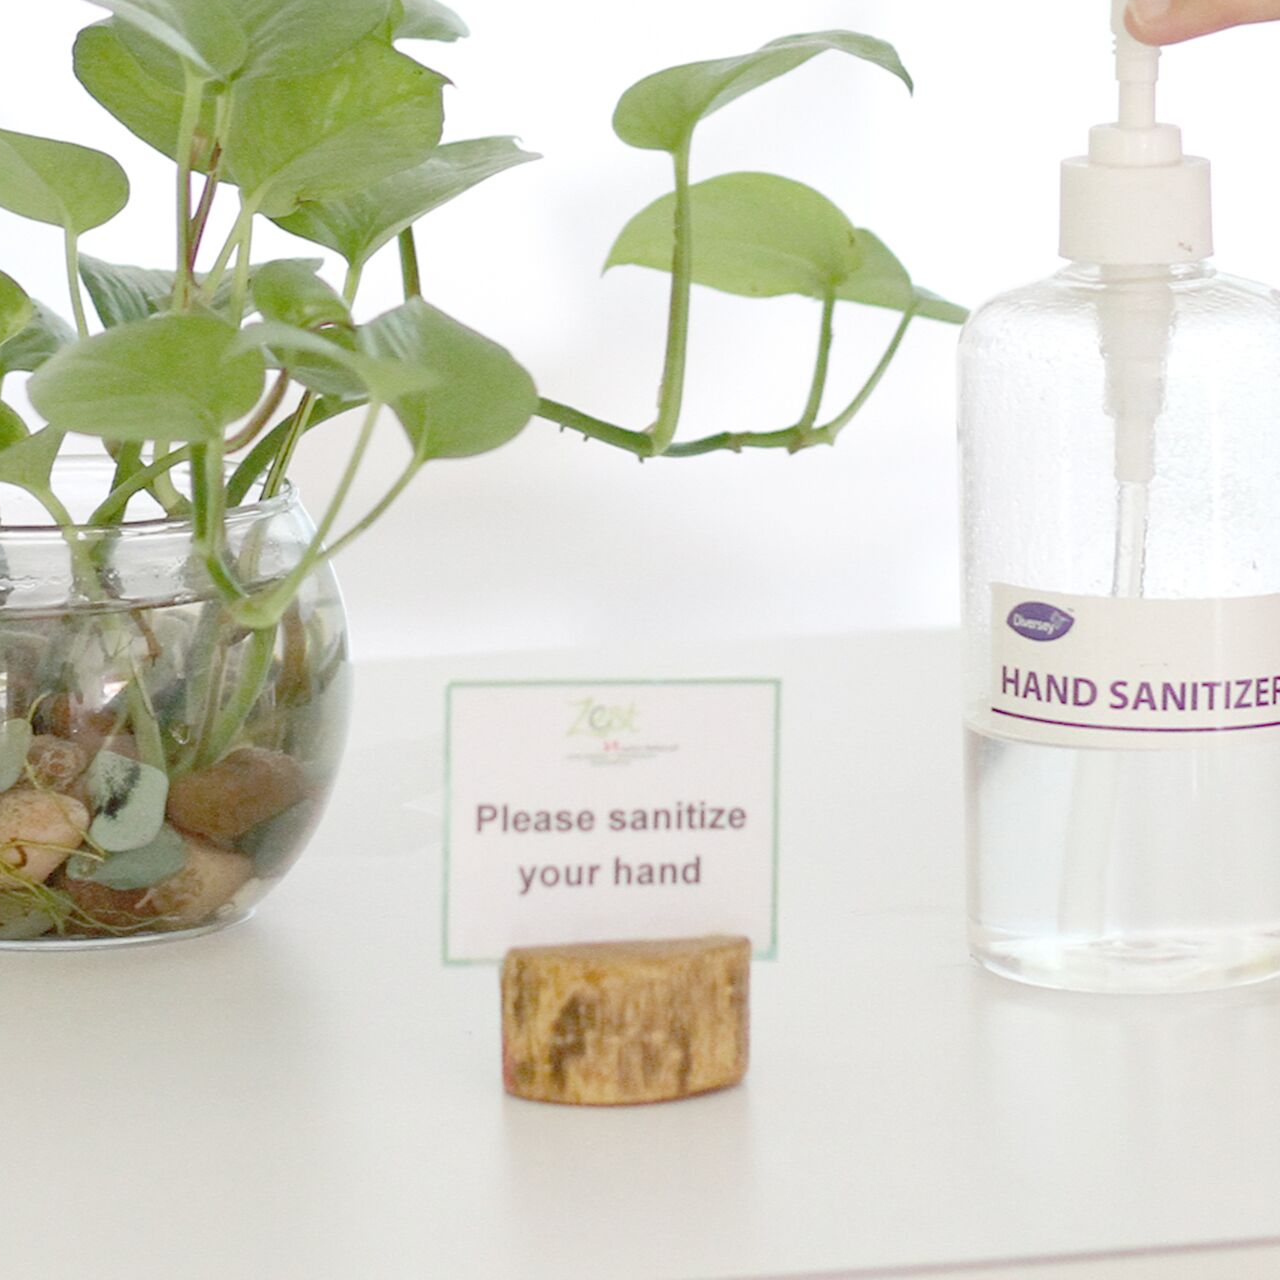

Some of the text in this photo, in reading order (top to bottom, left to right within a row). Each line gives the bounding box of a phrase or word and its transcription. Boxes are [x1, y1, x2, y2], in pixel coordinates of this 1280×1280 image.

[1002, 665, 1098, 707] HAND
[476, 801, 747, 833] Please sanitize
[519, 856, 702, 895] your hand
